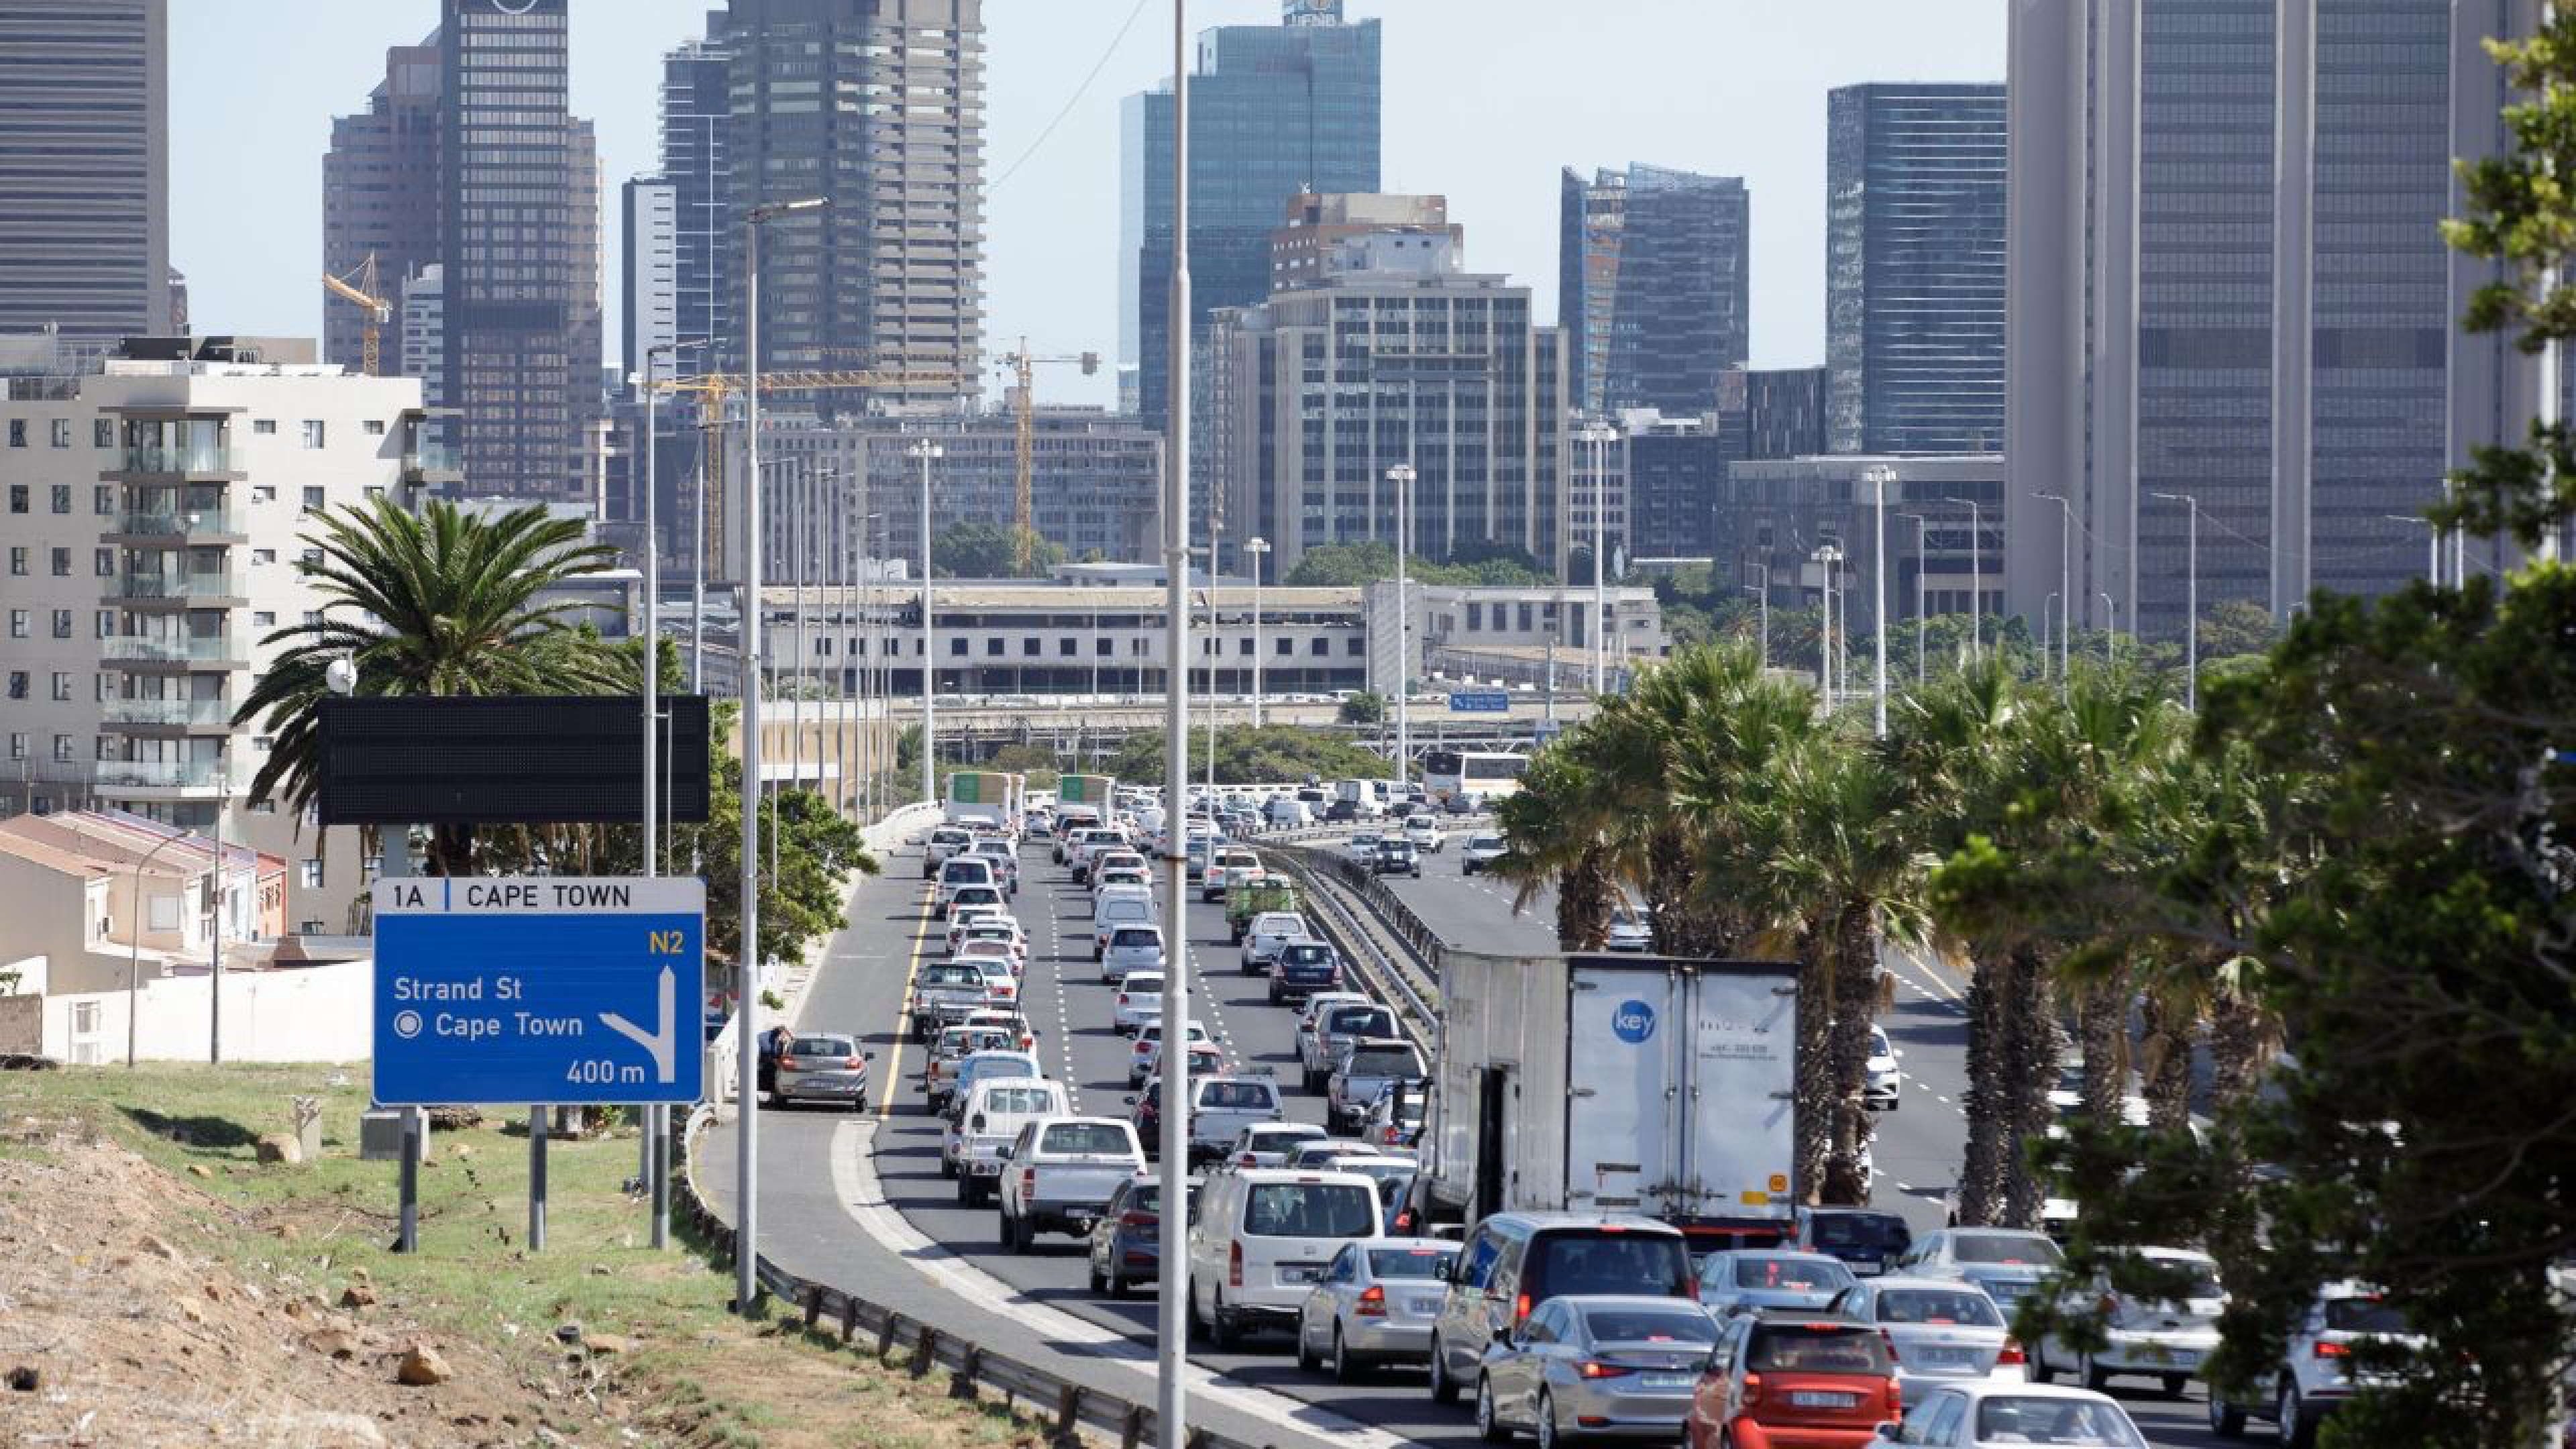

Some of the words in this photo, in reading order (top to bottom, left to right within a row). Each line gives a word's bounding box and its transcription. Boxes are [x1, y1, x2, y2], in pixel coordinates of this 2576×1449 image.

[394, 885, 423, 907] 1A
[468, 885, 537, 907] CAPE
[553, 885, 630, 907] TOWN
[649, 931, 684, 954] N2
[394, 977, 482, 1000] Strand
[496, 977, 522, 1000] St
[436, 1013, 500, 1041] Cape
[515, 1012, 583, 1036] Town
[1615, 1010, 1655, 1037] key
[567, 1060, 614, 1083] 400
[621, 1065, 645, 1083] m
